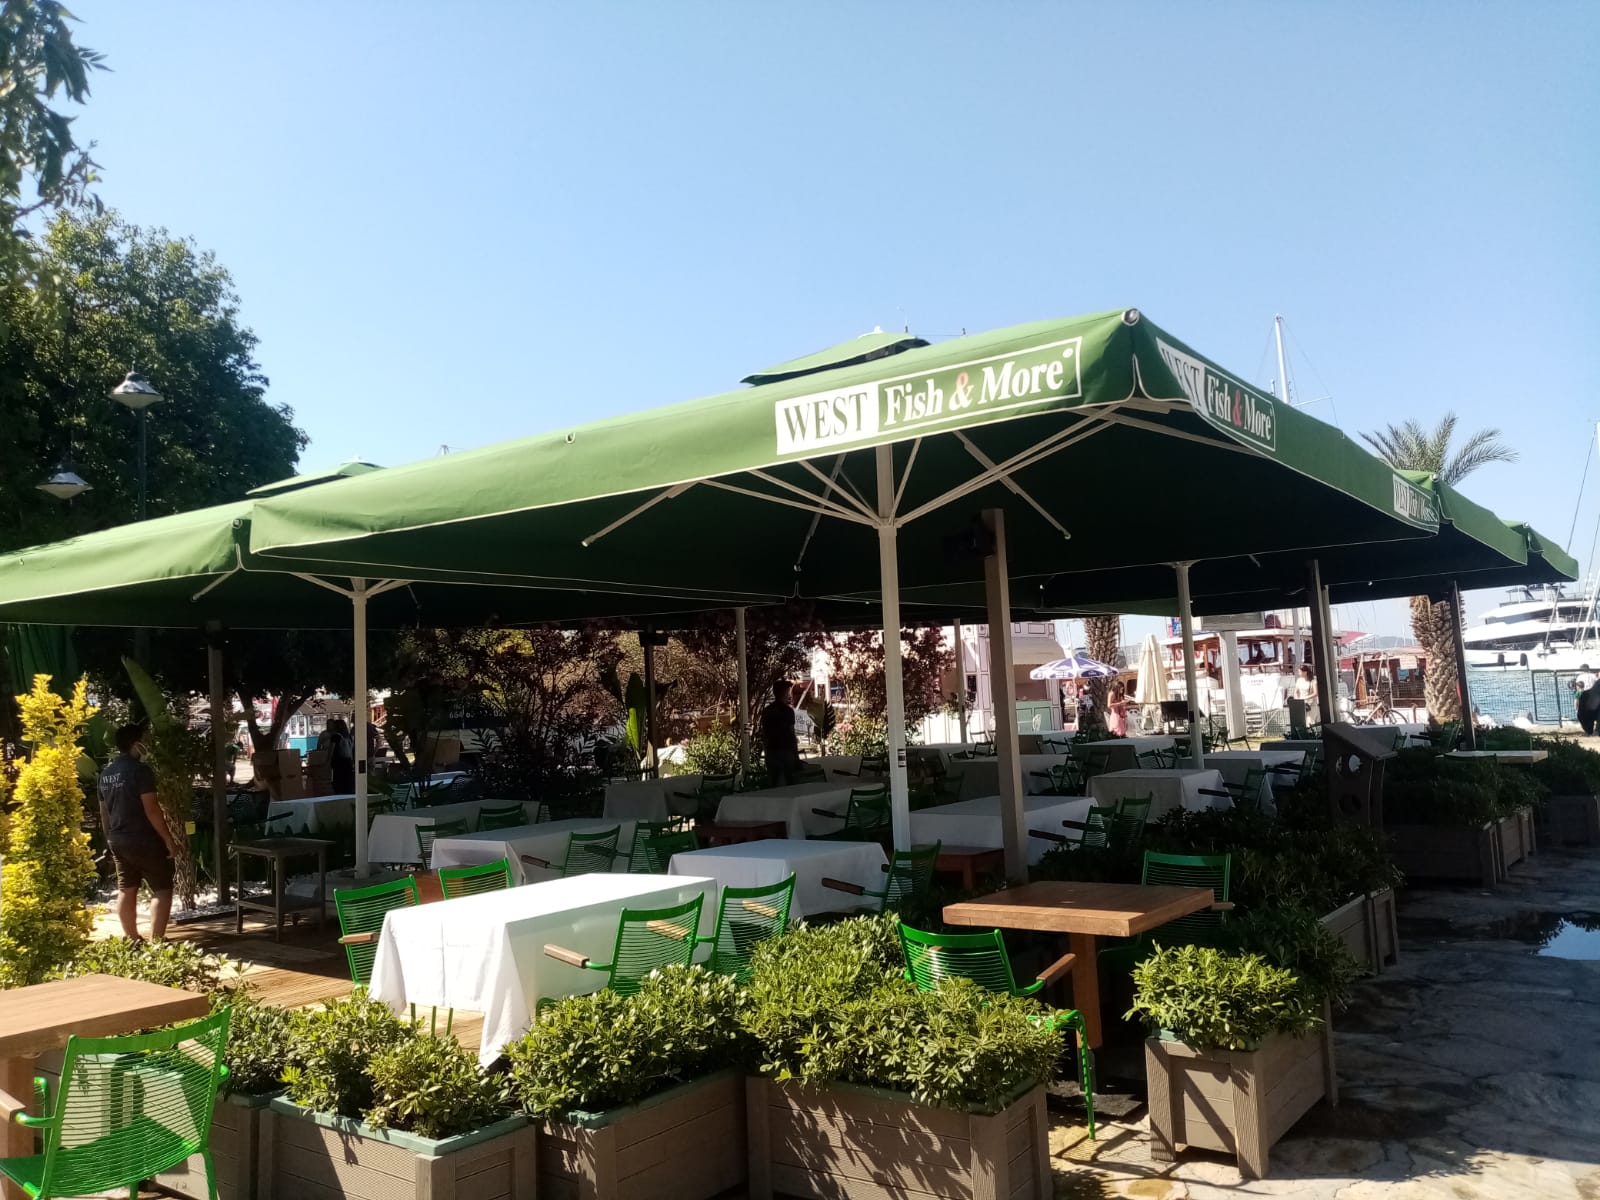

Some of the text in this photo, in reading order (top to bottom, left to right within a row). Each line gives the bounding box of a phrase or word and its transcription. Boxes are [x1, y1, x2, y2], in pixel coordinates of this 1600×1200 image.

[784, 360, 1064, 444] WEST Fish & More
[1207, 374, 1231, 422] Fish
[1232, 388, 1243, 427] &
[1243, 393, 1272, 440] More
